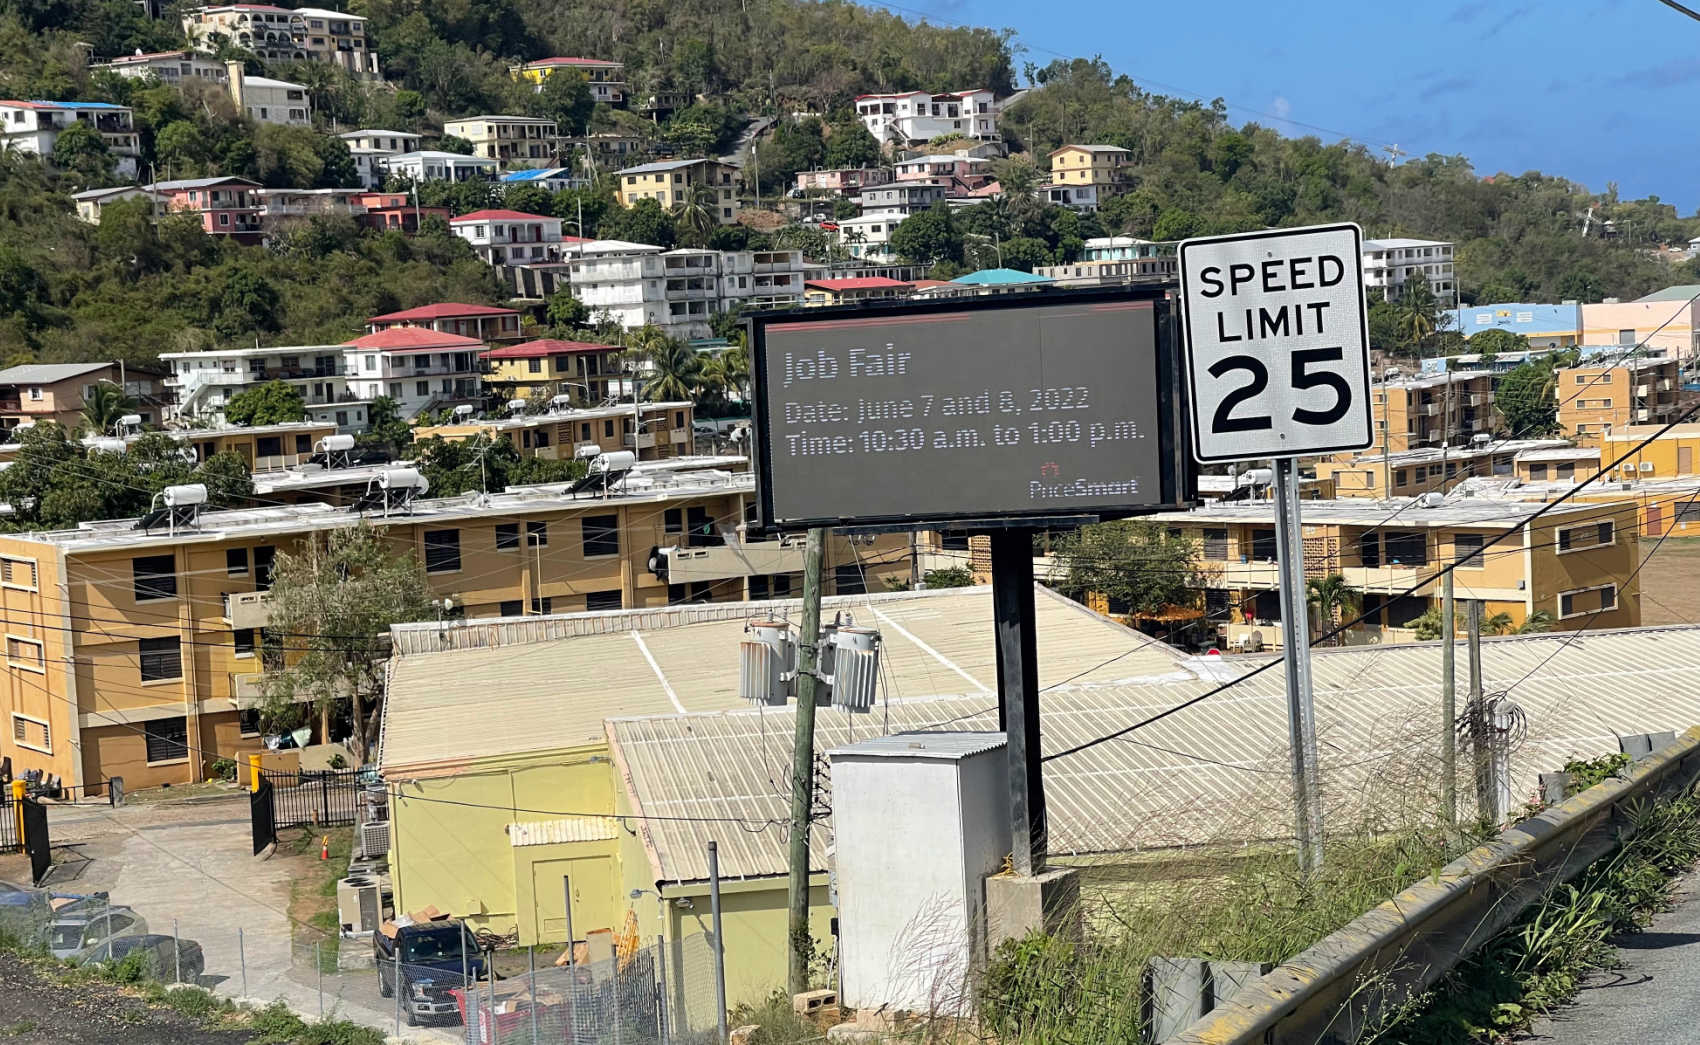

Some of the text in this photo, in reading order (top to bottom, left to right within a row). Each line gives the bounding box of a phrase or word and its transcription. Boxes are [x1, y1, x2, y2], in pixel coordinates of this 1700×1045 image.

[1200, 255, 1344, 297] SPEED
[1217, 301, 1330, 342] LIMIT
[783, 343, 911, 388] Job Fair
[785, 401, 848, 424] Date:
[857, 399, 913, 424] June
[920, 395, 934, 416] 7
[942, 389, 990, 415] and
[1029, 387, 1089, 411] 2022
[1208, 347, 1352, 433] 25
[785, 420, 1145, 455] Time: 10:30 a.m. to 1:00 p.m.
[1029, 478, 1139, 498] PriceSmart
